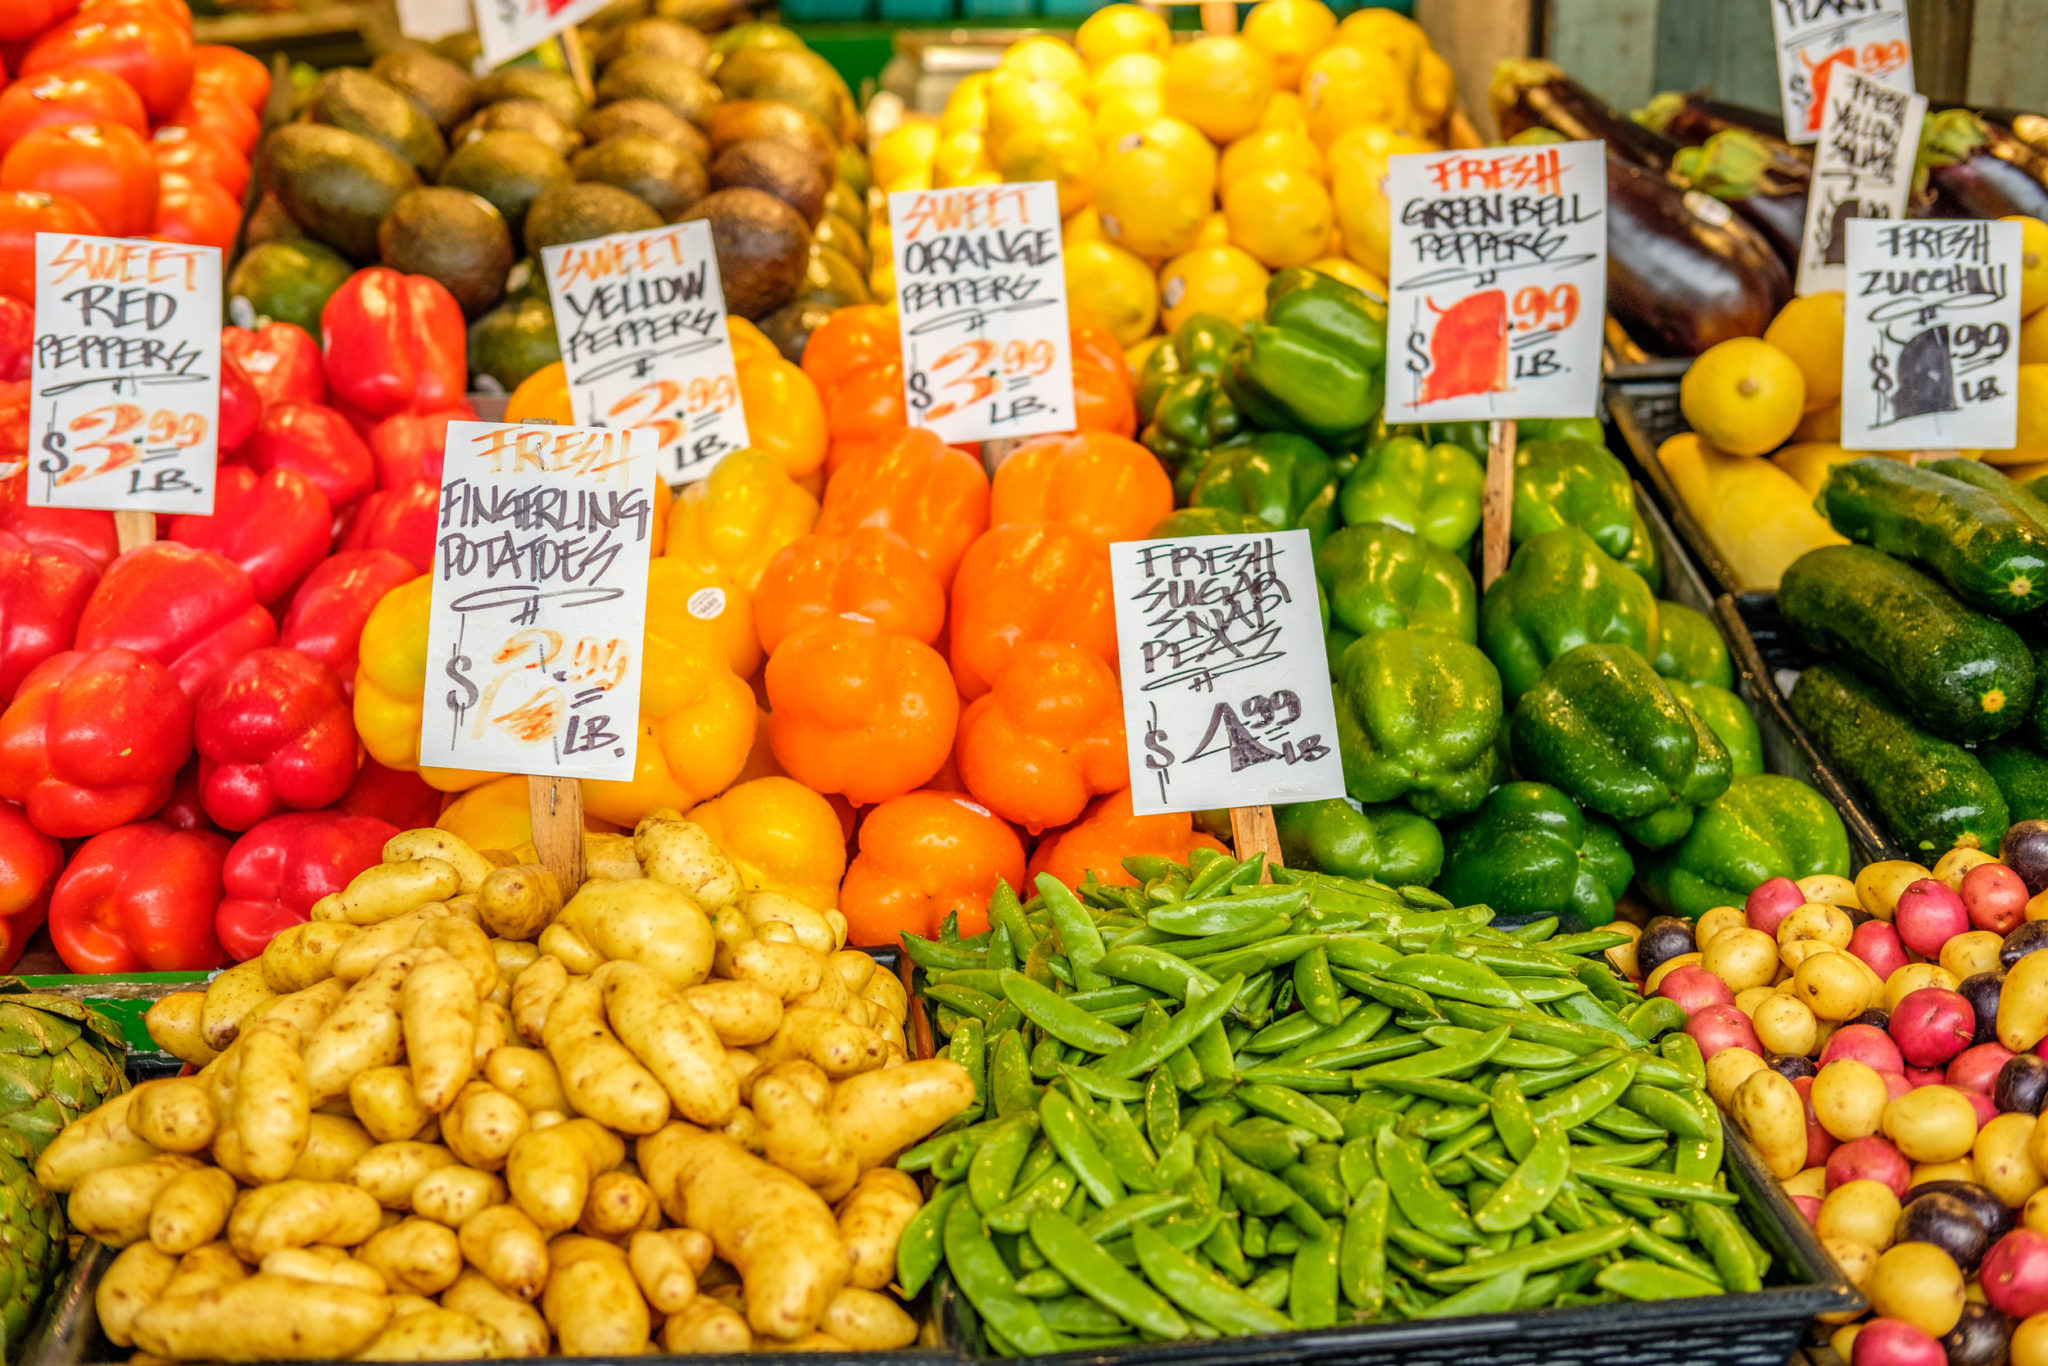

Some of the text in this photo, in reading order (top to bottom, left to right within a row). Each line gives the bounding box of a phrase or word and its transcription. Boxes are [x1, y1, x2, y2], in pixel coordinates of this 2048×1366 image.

[1425, 149, 1575, 198] FRESH
[902, 187, 1037, 240] SWEET
[1401, 193, 1602, 229] GREEN BELL
[48, 238, 208, 291] SWEET
[557, 227, 689, 292] SWEET
[904, 228, 1058, 275] ORANGE
[1410, 229, 1568, 265] PEPPERS
[1876, 221, 1990, 265] FRESH
[62, 285, 177, 331] RED
[564, 260, 706, 331] YELLOW
[902, 274, 1041, 314] PEPPERS
[36, 334, 202, 375] PEPPERS
[568, 308, 718, 363] PEPPERS
[989, 396, 1058, 424] LB.
[127, 469, 203, 495] LB.
[471, 426, 643, 492] FRESH
[440, 477, 651, 541] FINGERLING
[439, 530, 624, 586] POTATOES
[1136, 538, 1286, 578] FRESH
[1130, 570, 1292, 613] SUGAR
[1146, 593, 1283, 638] SNAP
[1140, 619, 1283, 674] PEAS
[562, 715, 625, 757] LB.
